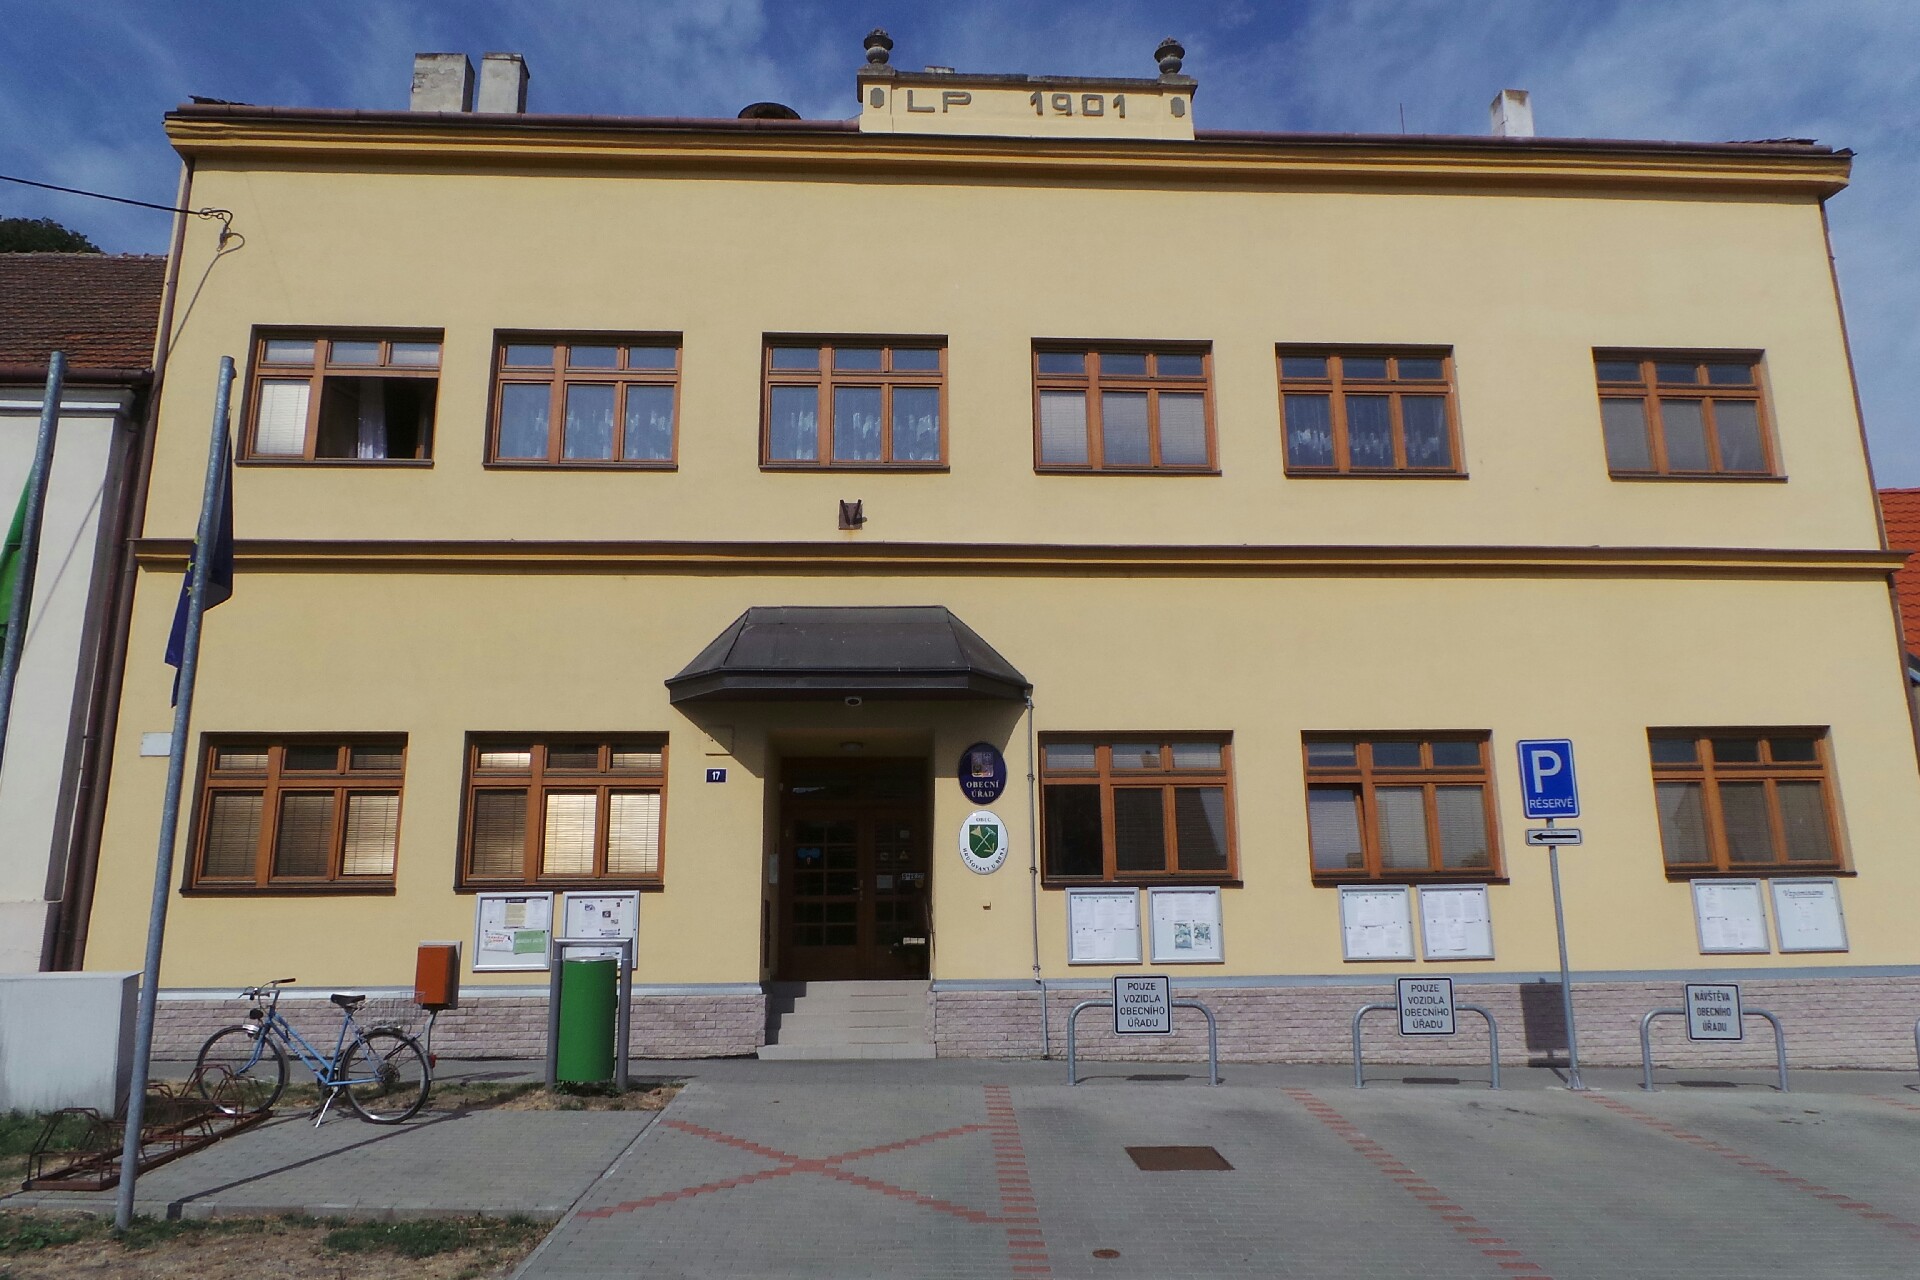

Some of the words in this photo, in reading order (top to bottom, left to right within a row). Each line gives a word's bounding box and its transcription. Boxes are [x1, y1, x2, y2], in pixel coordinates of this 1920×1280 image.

[1029, 90, 1126, 119] 1901
[712, 771, 721, 780] 17
[1531, 750, 1562, 793] P
[966, 780, 999, 788] OBECNÍ
[971, 789, 995, 798] ÚŘAD
[1127, 982, 1156, 991] POUZE
[1411, 984, 1440, 992] POUZE
[1123, 994, 1161, 1003] VOZIDLA
[1694, 989, 1731, 1001] NÁVŠTĚVA
[1407, 996, 1445, 1005] VOZIDLA
[1120, 1005, 1165, 1015] OBECNÍHO
[1404, 1007, 1449, 1017] OBECNÍHO
[1696, 1005, 1732, 1017] OBECNÍHO
[1127, 1017, 1159, 1027] ÚŘADU
[1412, 1018, 1443, 1029] ÚŘADU
[1702, 1020, 1728, 1032] ÚŘADU
